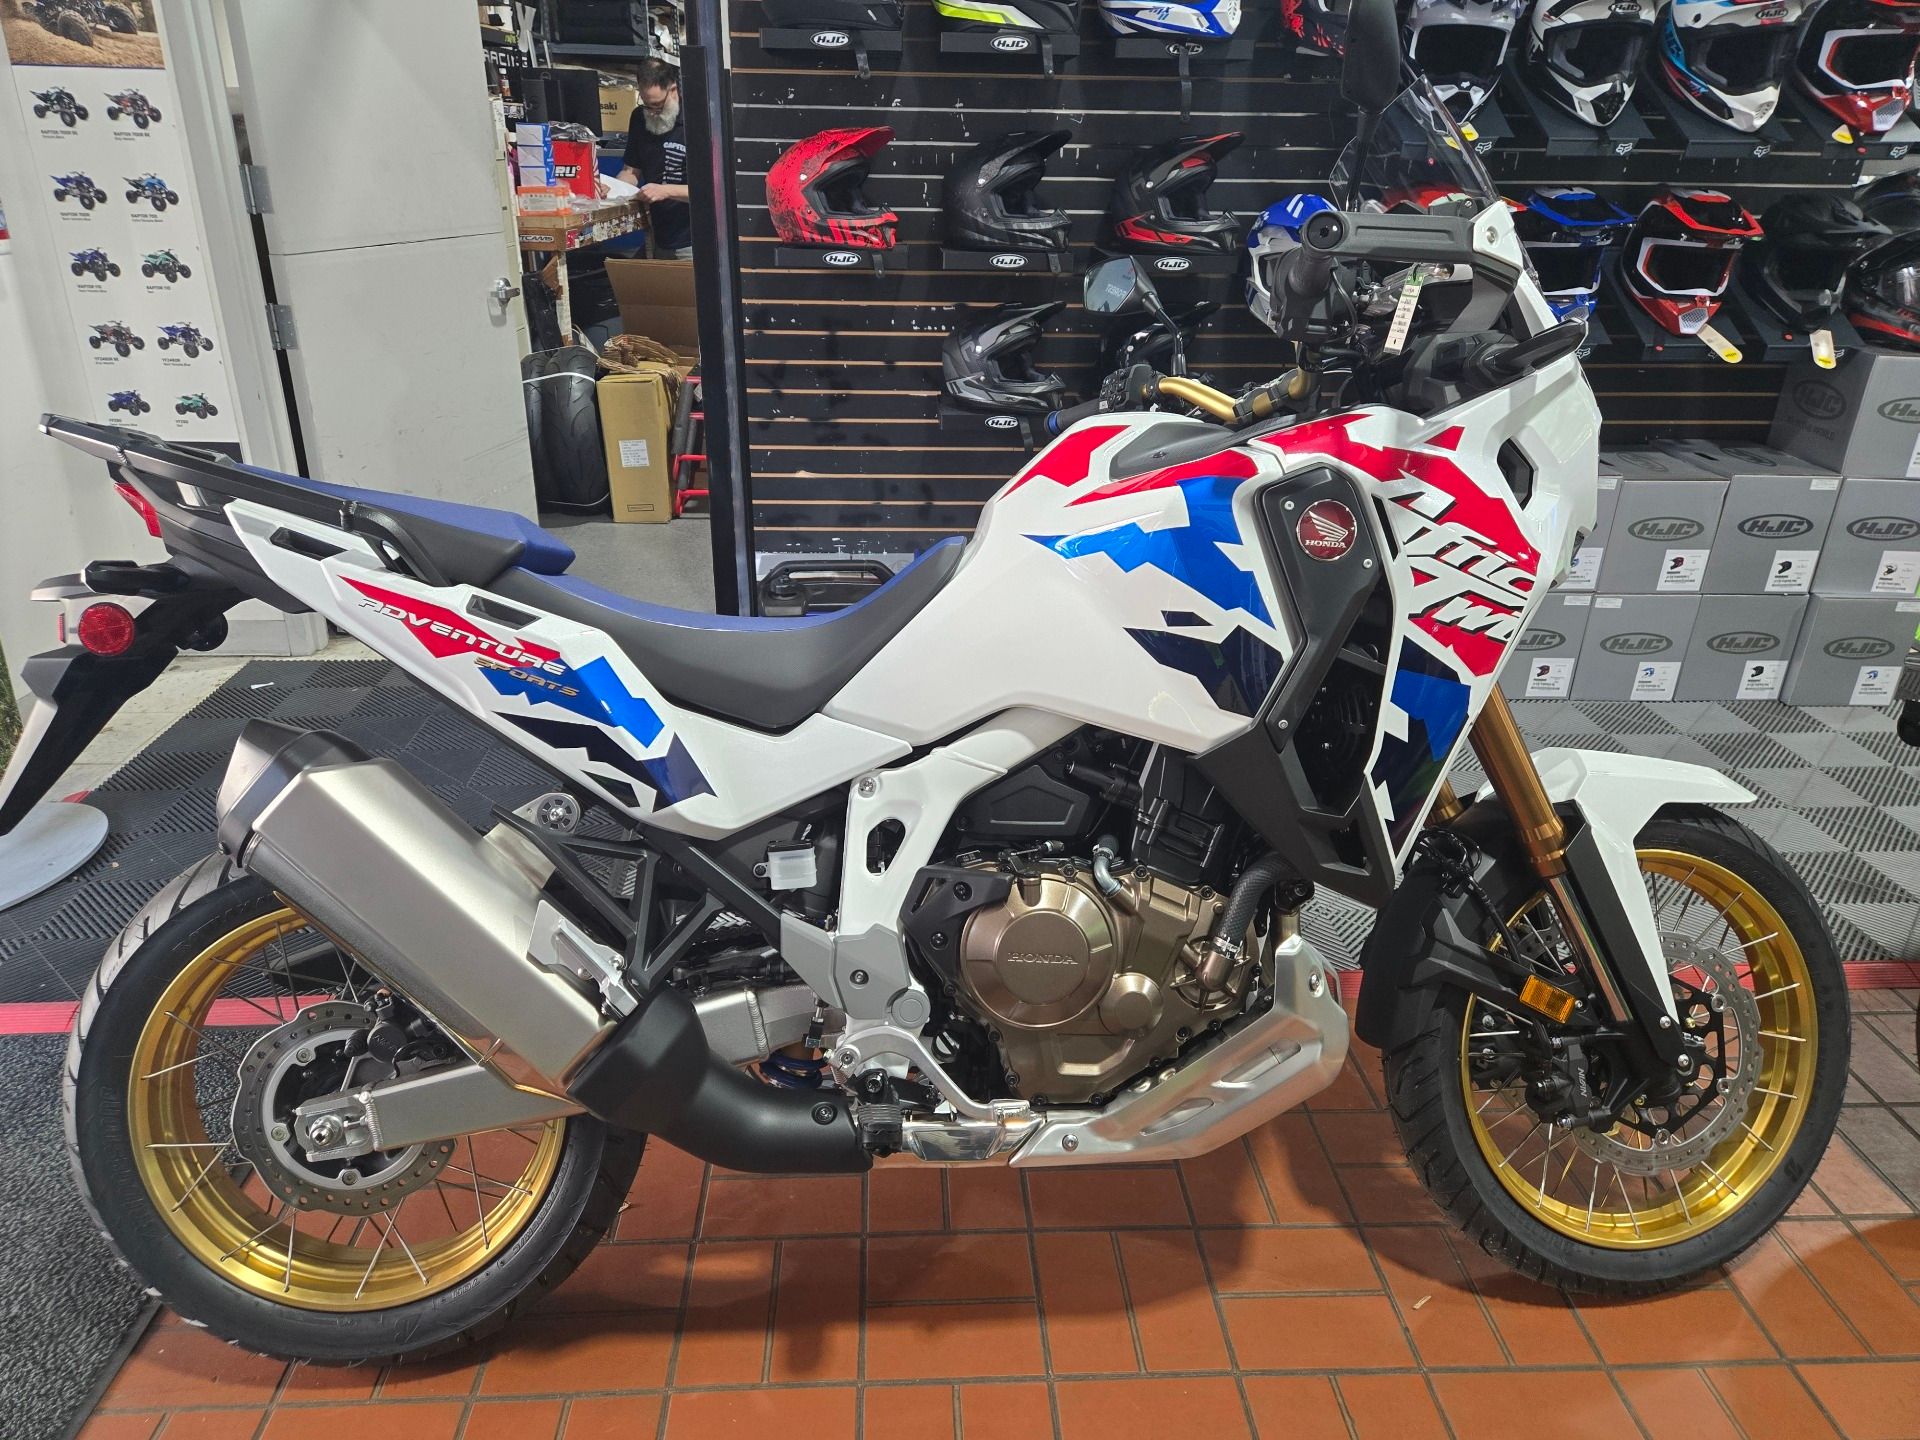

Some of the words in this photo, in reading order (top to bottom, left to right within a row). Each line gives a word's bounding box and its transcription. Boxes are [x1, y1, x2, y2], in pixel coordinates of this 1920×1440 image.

[1760, 10, 1786, 18] HJC
[816, 35, 846, 44] HJC
[996, 40, 1026, 48] HJC
[600, 101, 617, 111] saki
[828, 255, 856, 263] HJC
[995, 257, 1022, 265] HJC
[1637, 522, 1696, 536] HJC
[1748, 520, 1805, 533] HJC
[1856, 522, 1915, 535] HJC
[1305, 539, 1347, 548] HONDA
[358, 598, 566, 676] ADVENTURE
[1715, 636, 1772, 649] HJC
[1608, 637, 1665, 650] HJC
[1831, 642, 1887, 654] HJC
[473, 656, 580, 697] SPORTS
[1007, 952, 1078, 964] HONDA
